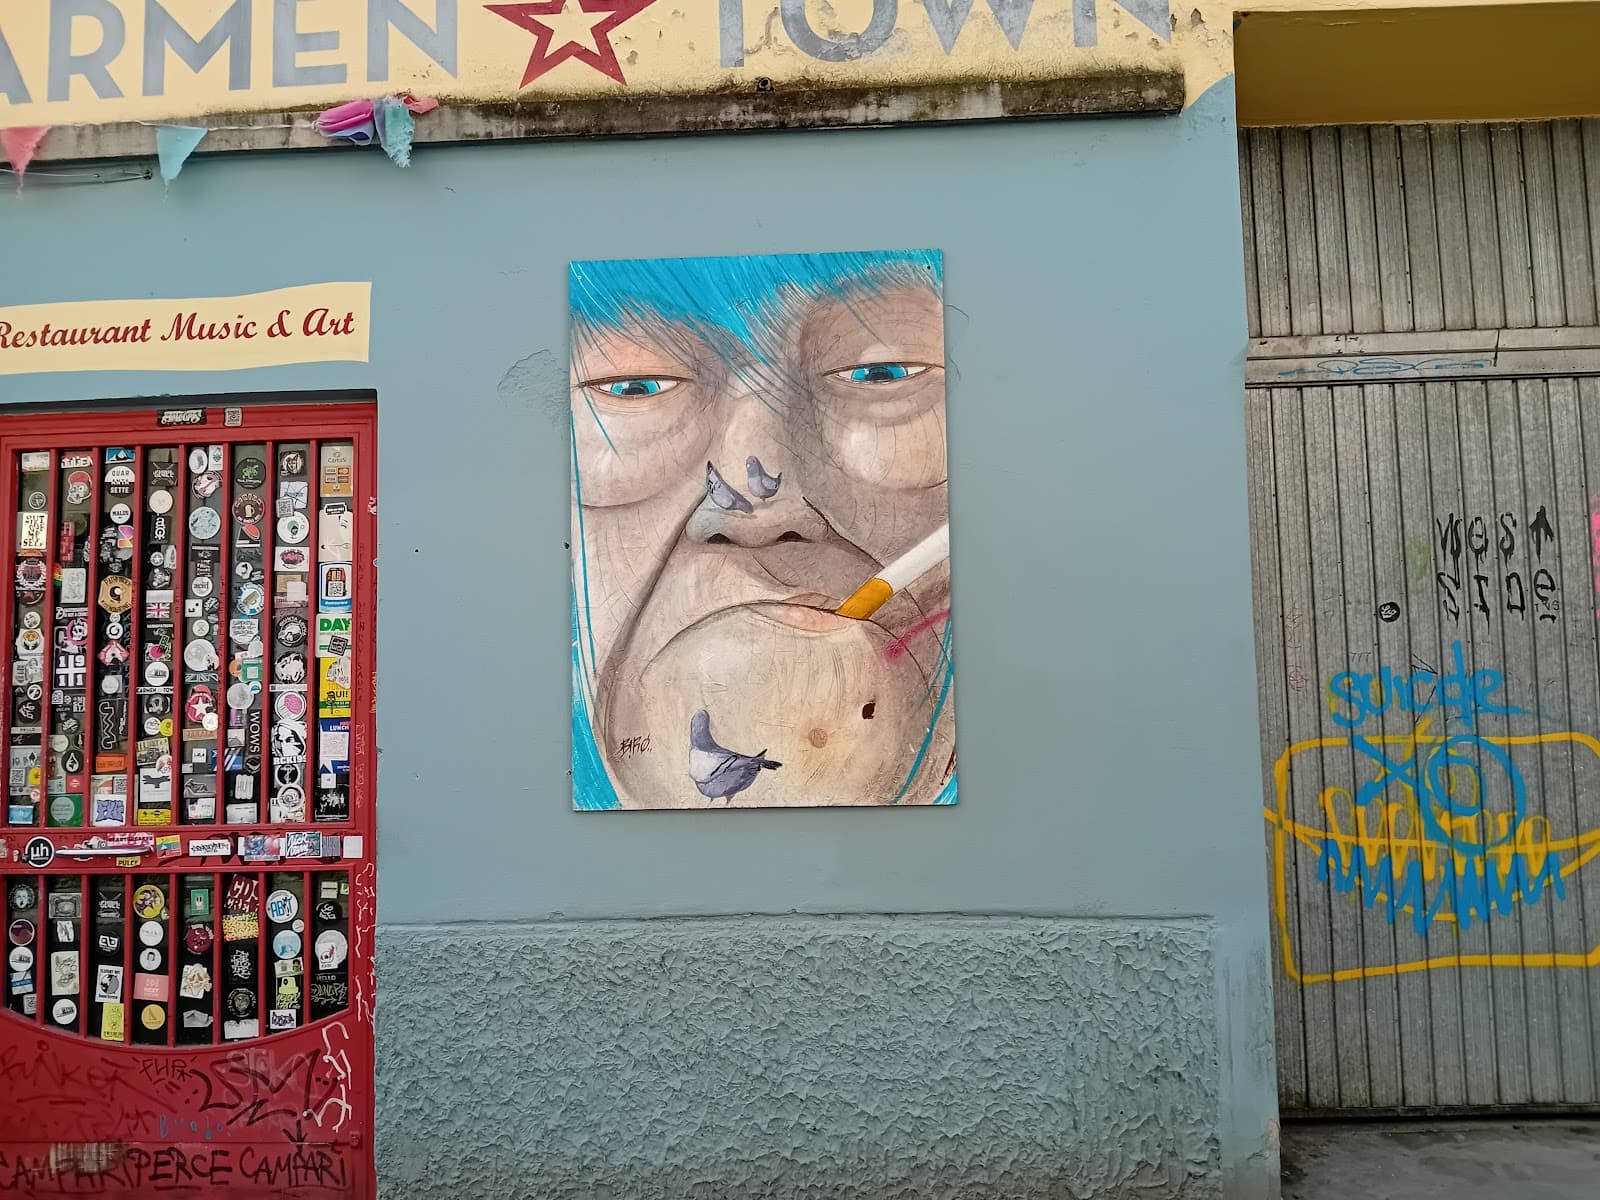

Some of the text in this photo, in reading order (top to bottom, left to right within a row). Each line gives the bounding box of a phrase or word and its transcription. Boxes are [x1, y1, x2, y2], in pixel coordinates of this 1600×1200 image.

[0, 308, 355, 349] Restaurant Music & Art
